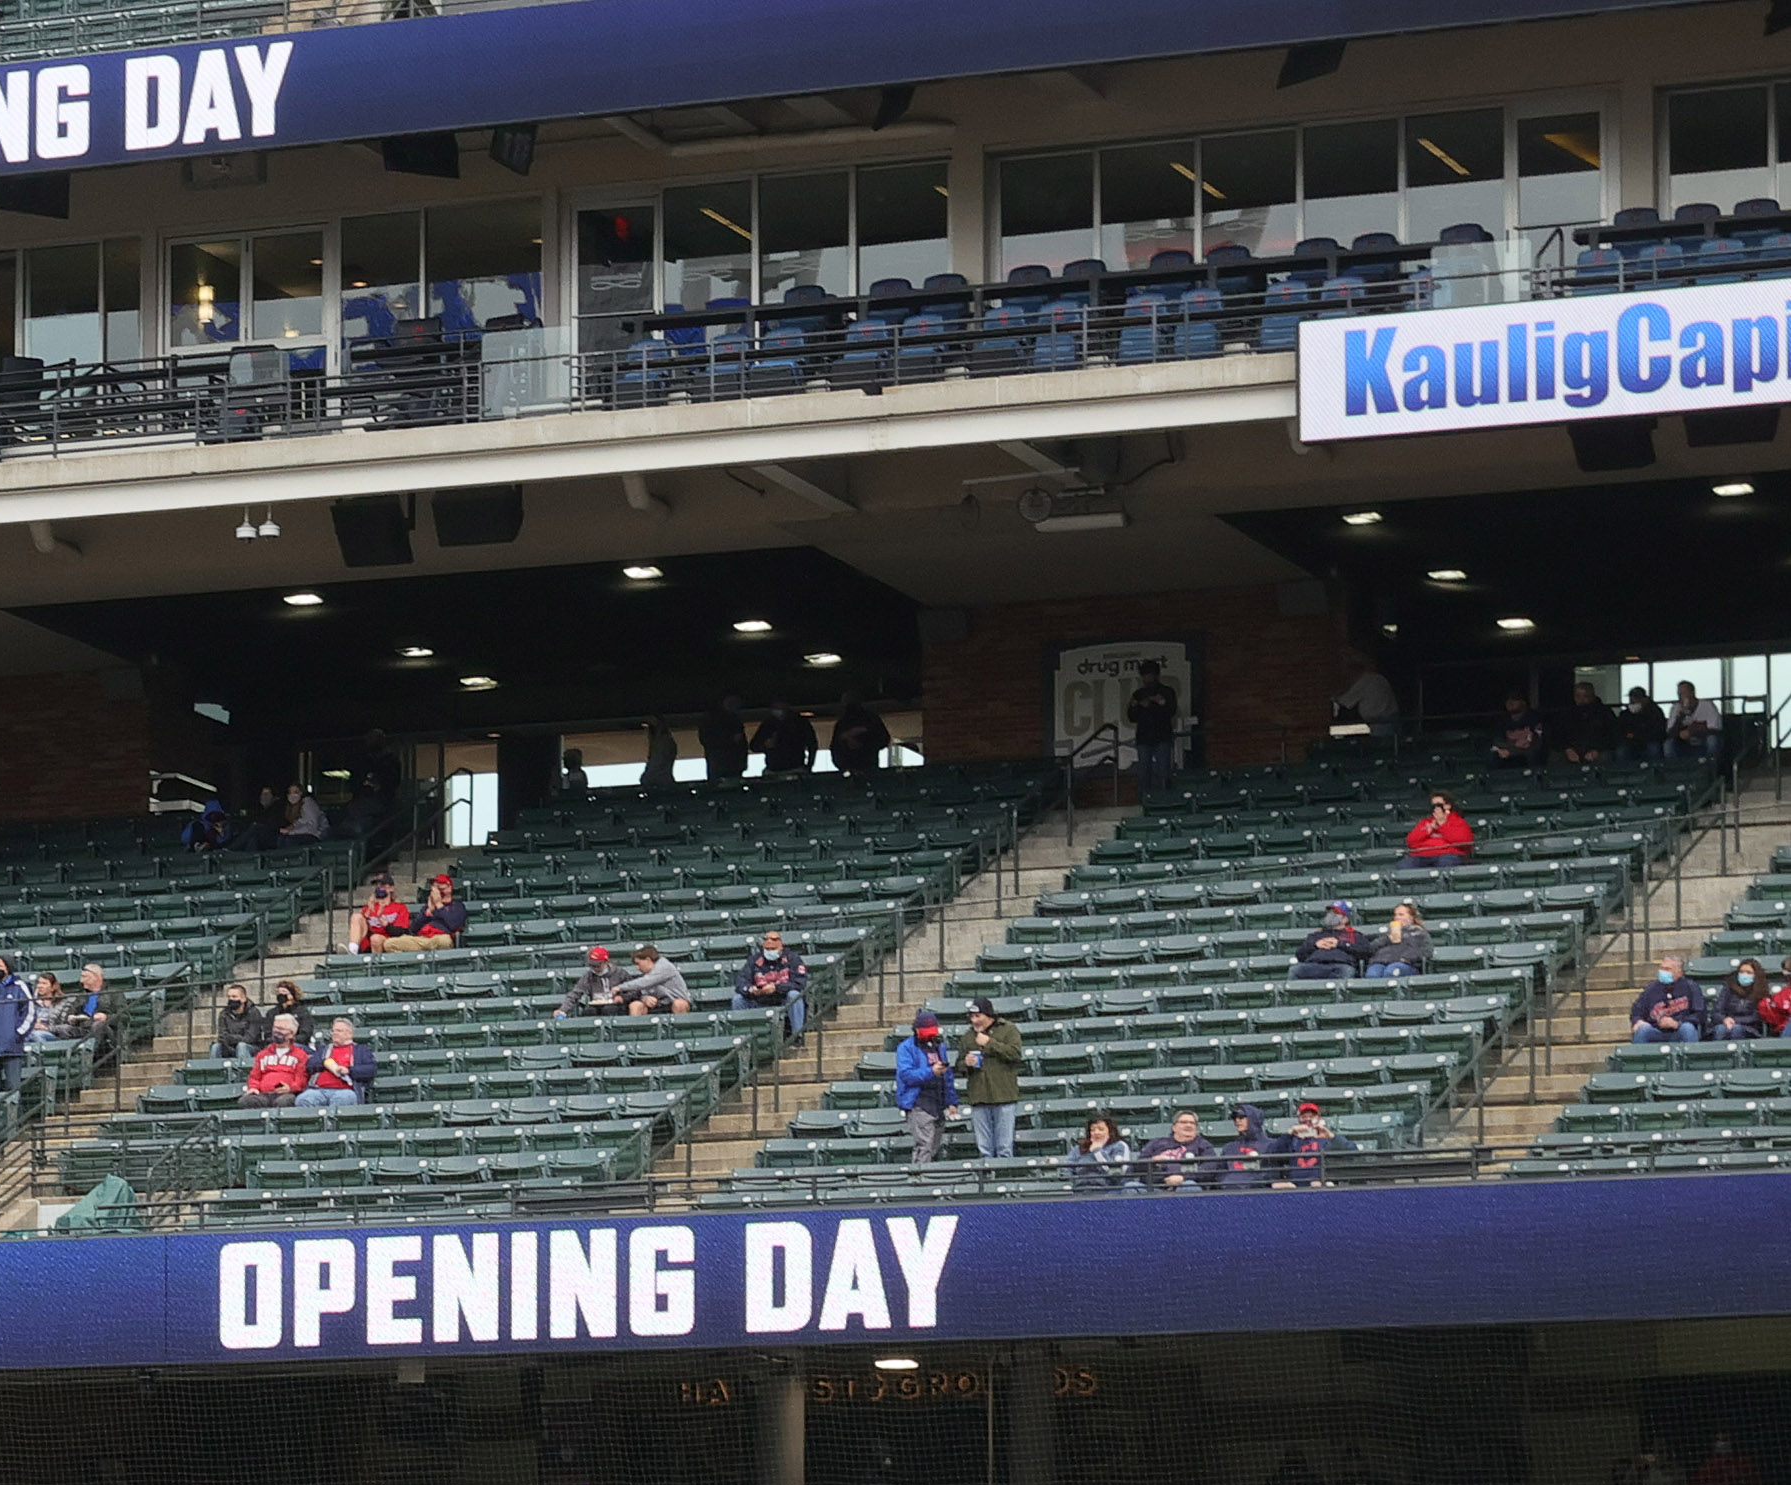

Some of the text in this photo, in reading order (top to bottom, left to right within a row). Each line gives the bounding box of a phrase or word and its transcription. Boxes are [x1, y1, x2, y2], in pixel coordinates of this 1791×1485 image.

[125, 41, 294, 152] DAY
[1344, 302, 1791, 418] KauligCap
[1077, 658, 1119, 677] drug
[1124, 655, 1168, 672] mt
[219, 1215, 959, 1350] OPENING DAY
